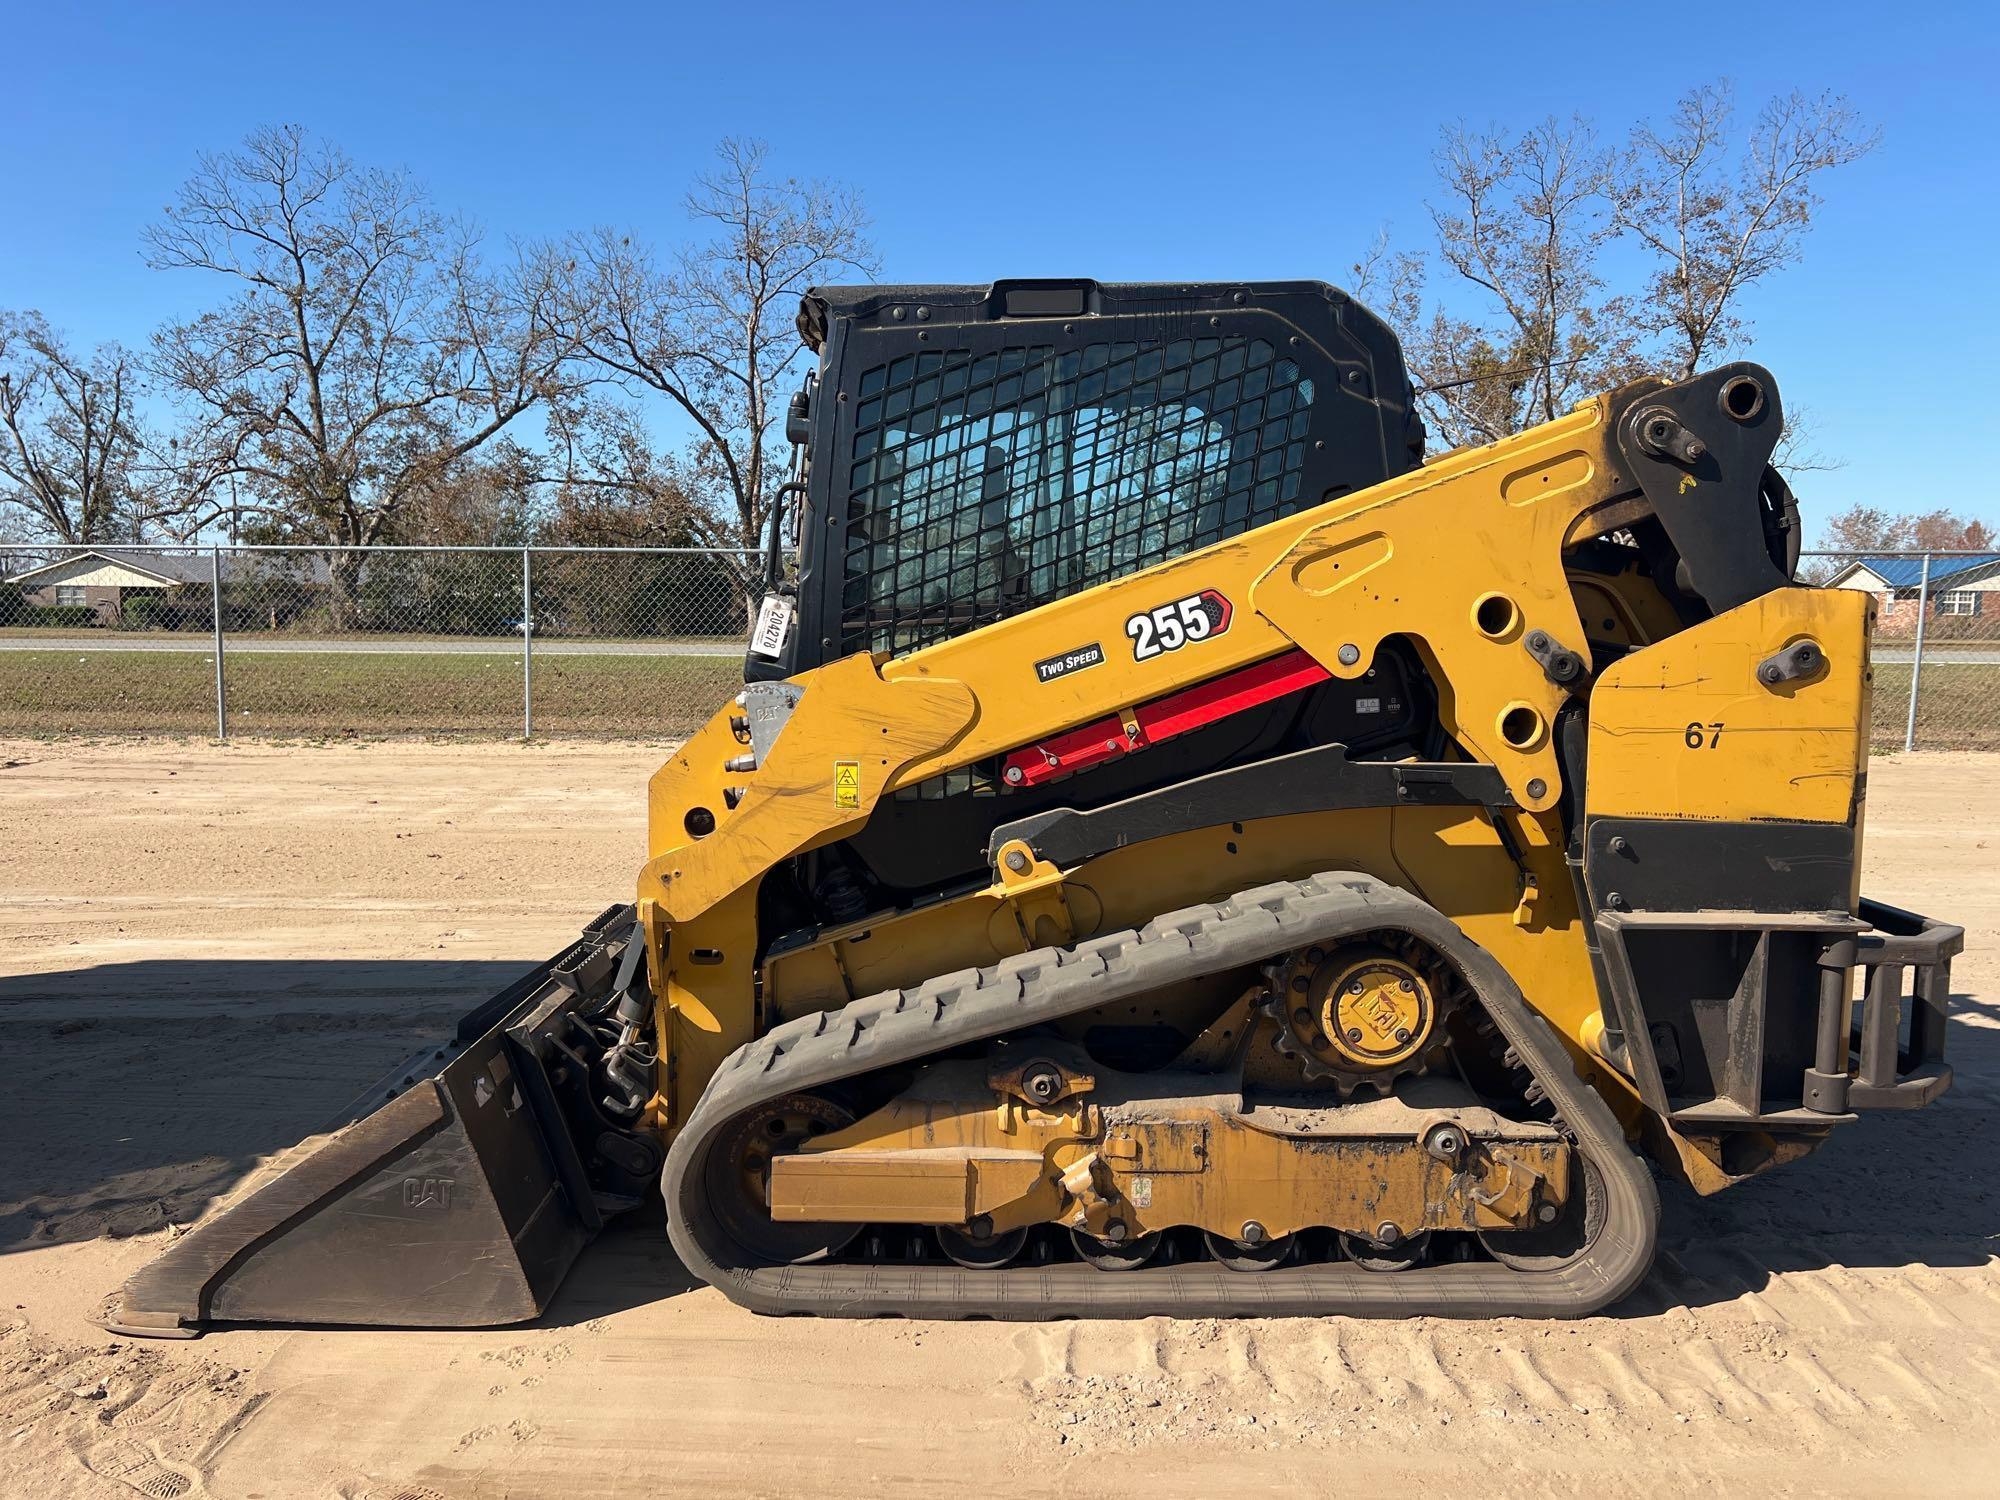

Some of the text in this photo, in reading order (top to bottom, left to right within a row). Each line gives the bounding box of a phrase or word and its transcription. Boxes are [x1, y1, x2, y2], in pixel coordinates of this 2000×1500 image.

[763, 610, 785, 649] 204278
[1127, 595, 1211, 660] 255
[1685, 721, 1725, 749] 67
[403, 1178, 456, 1209] CAT
